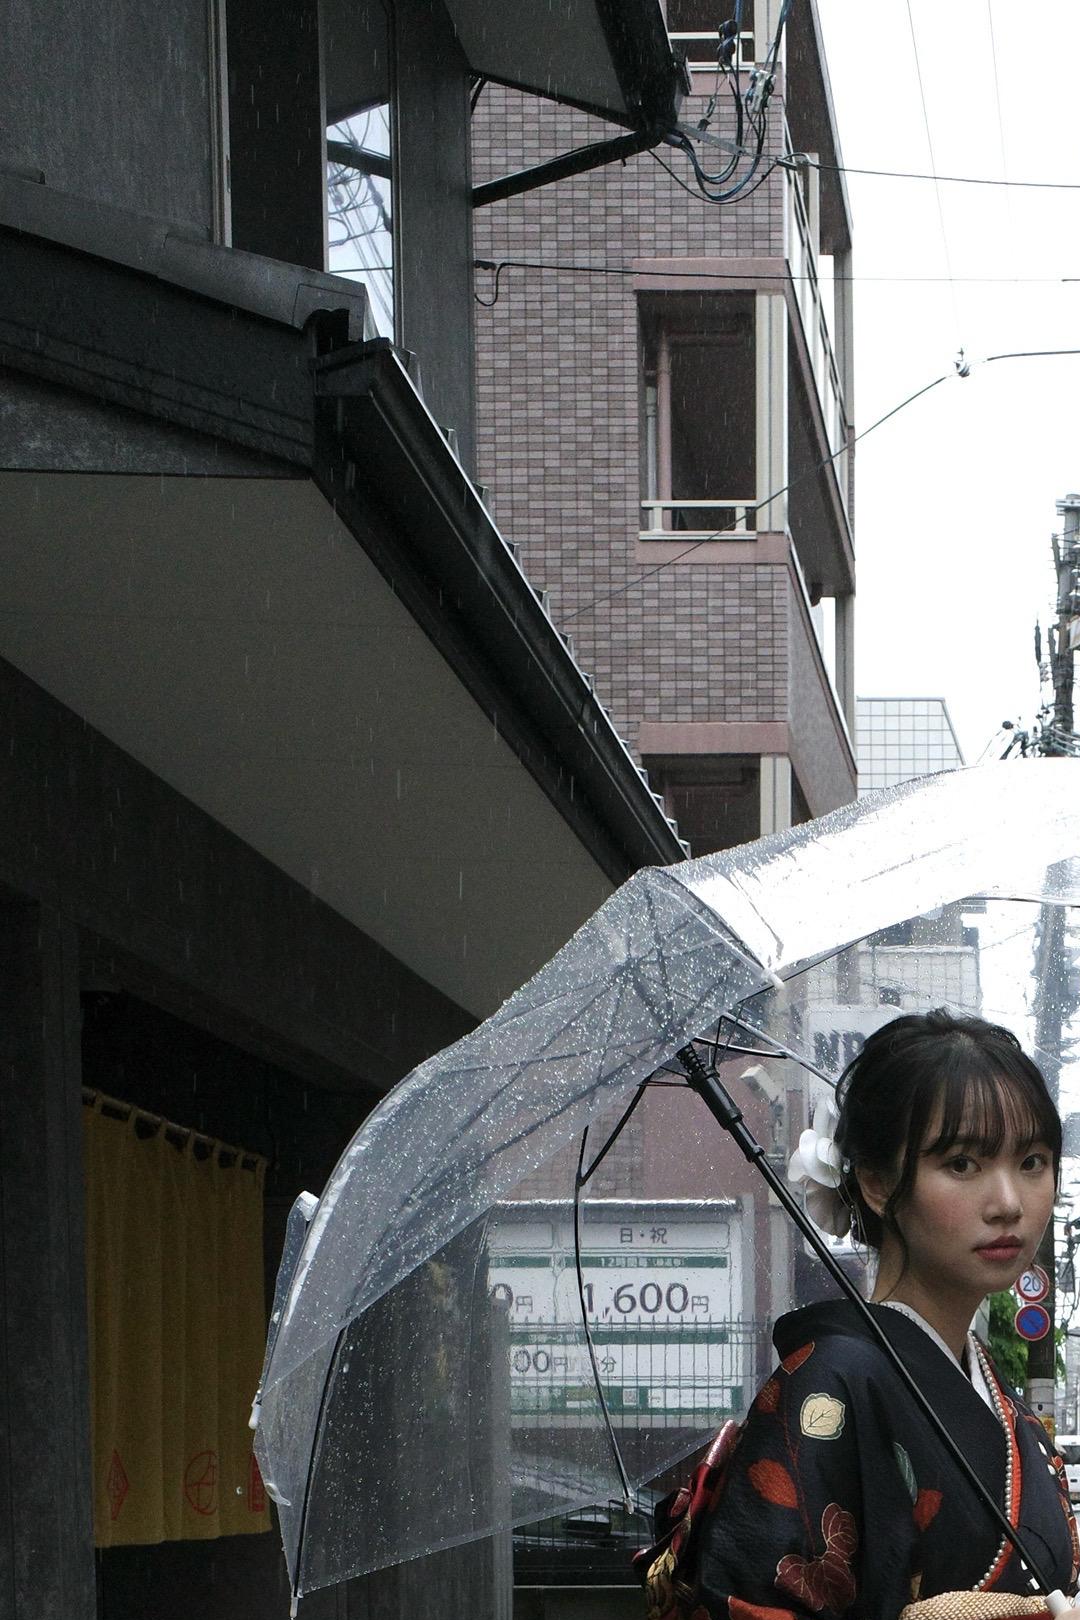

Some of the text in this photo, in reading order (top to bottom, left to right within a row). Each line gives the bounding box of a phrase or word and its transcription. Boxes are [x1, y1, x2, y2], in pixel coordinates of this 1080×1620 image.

[619, 1227, 668, 1245] 日・祝
[1022, 1275, 1042, 1292] 20
